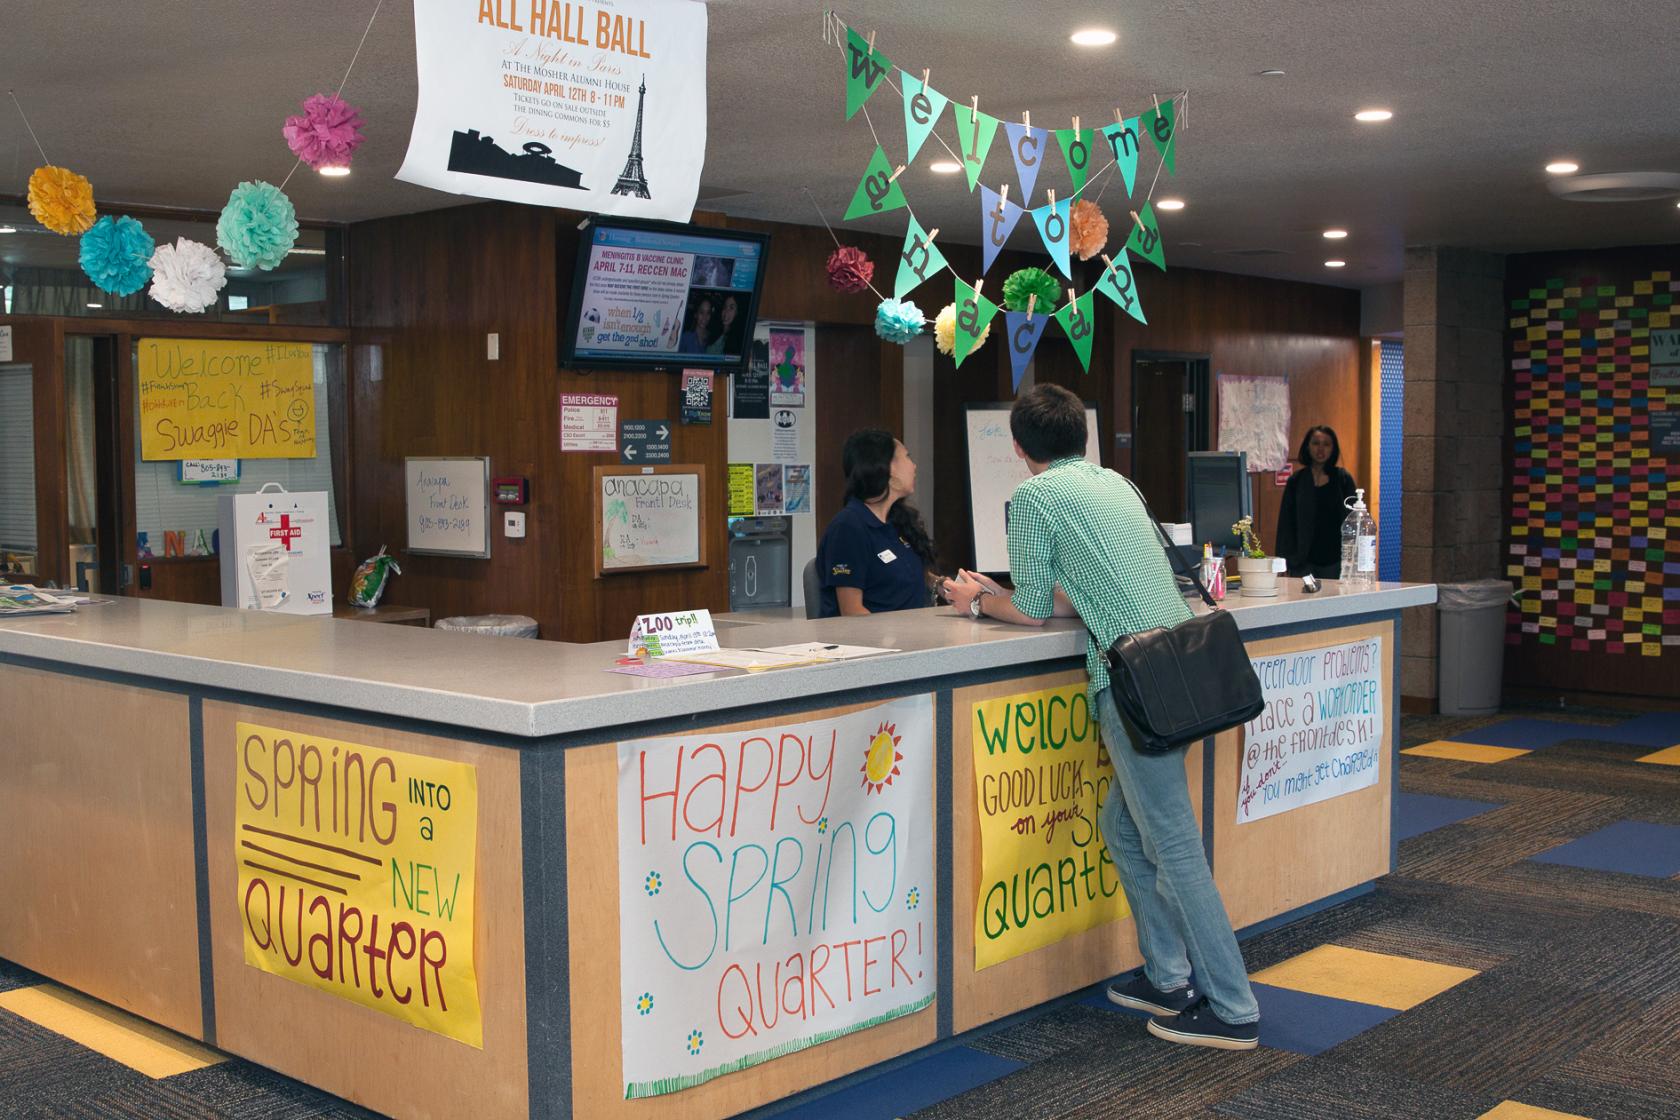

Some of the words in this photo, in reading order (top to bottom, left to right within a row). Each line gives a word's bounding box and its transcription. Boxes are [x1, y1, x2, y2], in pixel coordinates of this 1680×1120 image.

[478, 0, 523, 32] ALL
[530, 0, 589, 46] HALL
[596, 10, 651, 59] BALL
[527, 41, 569, 67] Night
[568, 58, 582, 67] in
[588, 52, 622, 75] Paris
[501, 59, 513, 70] AT
[514, 61, 531, 73] THE
[533, 66, 569, 81] MOSHER
[570, 73, 602, 88] ALUMNI
[605, 79, 631, 93] HOUSE
[503, 73, 542, 93] SATURDAY
[544, 82, 565, 98] APRIL
[568, 86, 587, 102] 12TH
[590, 91, 596, 103] 8
[513, 93, 541, 105] TICKETS
[541, 97, 552, 107] GO
[552, 101, 563, 109] ON
[564, 104, 578, 113] SALE
[579, 107, 606, 117] OUTSIDE
[513, 104, 526, 113] THE
[528, 107, 553, 119] DINING
[554, 112, 588, 124] COMMONS
[588, 118, 602, 127] FOR
[847, 43, 1170, 169] welcome
[511, 116, 544, 135] Dress
[549, 128, 557, 139] to
[560, 134, 606, 149] impress!
[989, 200, 1065, 248] to
[593, 261, 616, 272] APRIL
[620, 263, 635, 274] 7-11,
[670, 267, 688, 278] MAC
[602, 250, 634, 261] MENINGITIS
[642, 254, 667, 264] VACCINE
[667, 256, 685, 265] CLINIC
[608, 306, 631, 318] when
[632, 307, 645, 323] 1/2
[620, 322, 653, 336] enough
[597, 332, 611, 344] get
[612, 331, 625, 342] the
[624, 333, 640, 347] 2nd
[150, 343, 265, 379] Welcome
[562, 395, 617, 405] EMERGENCY
[157, 418, 239, 451] Swaggie
[604, 478, 683, 508] anacapa
[635, 497, 660, 508] Front
[669, 494, 692, 509] Desk
[290, 529, 301, 537] AID
[642, 616, 673, 634] ZOO
[1302, 692, 1315, 726] a
[409, 777, 451, 811] INTO
[983, 767, 1036, 817] GOOD
[1038, 760, 1084, 806] LUCK
[1241, 774, 1251, 794] if
[1284, 770, 1313, 796] might
[1315, 763, 1330, 786] get
[419, 817, 433, 842] a
[1010, 816, 1036, 836] on
[1041, 801, 1084, 844] your
[391, 857, 460, 922] NEW
